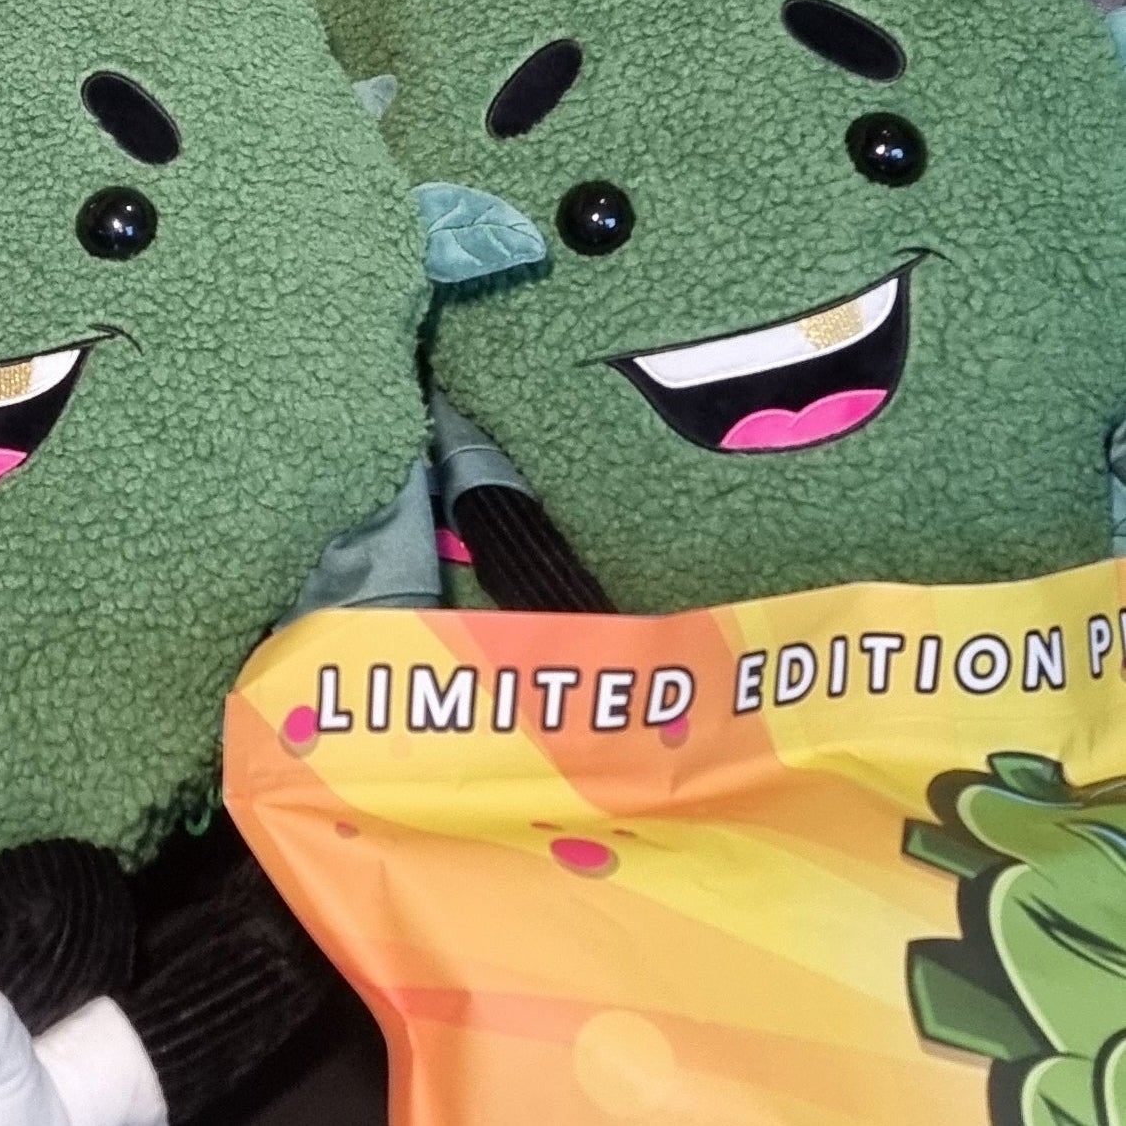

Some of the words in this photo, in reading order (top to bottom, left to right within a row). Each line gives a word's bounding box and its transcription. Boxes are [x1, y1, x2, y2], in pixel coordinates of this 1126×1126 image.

[316, 663, 695, 734] LIMITED
[732, 626, 1066, 716] EDITION
[1088, 607, 1126, 679] P
